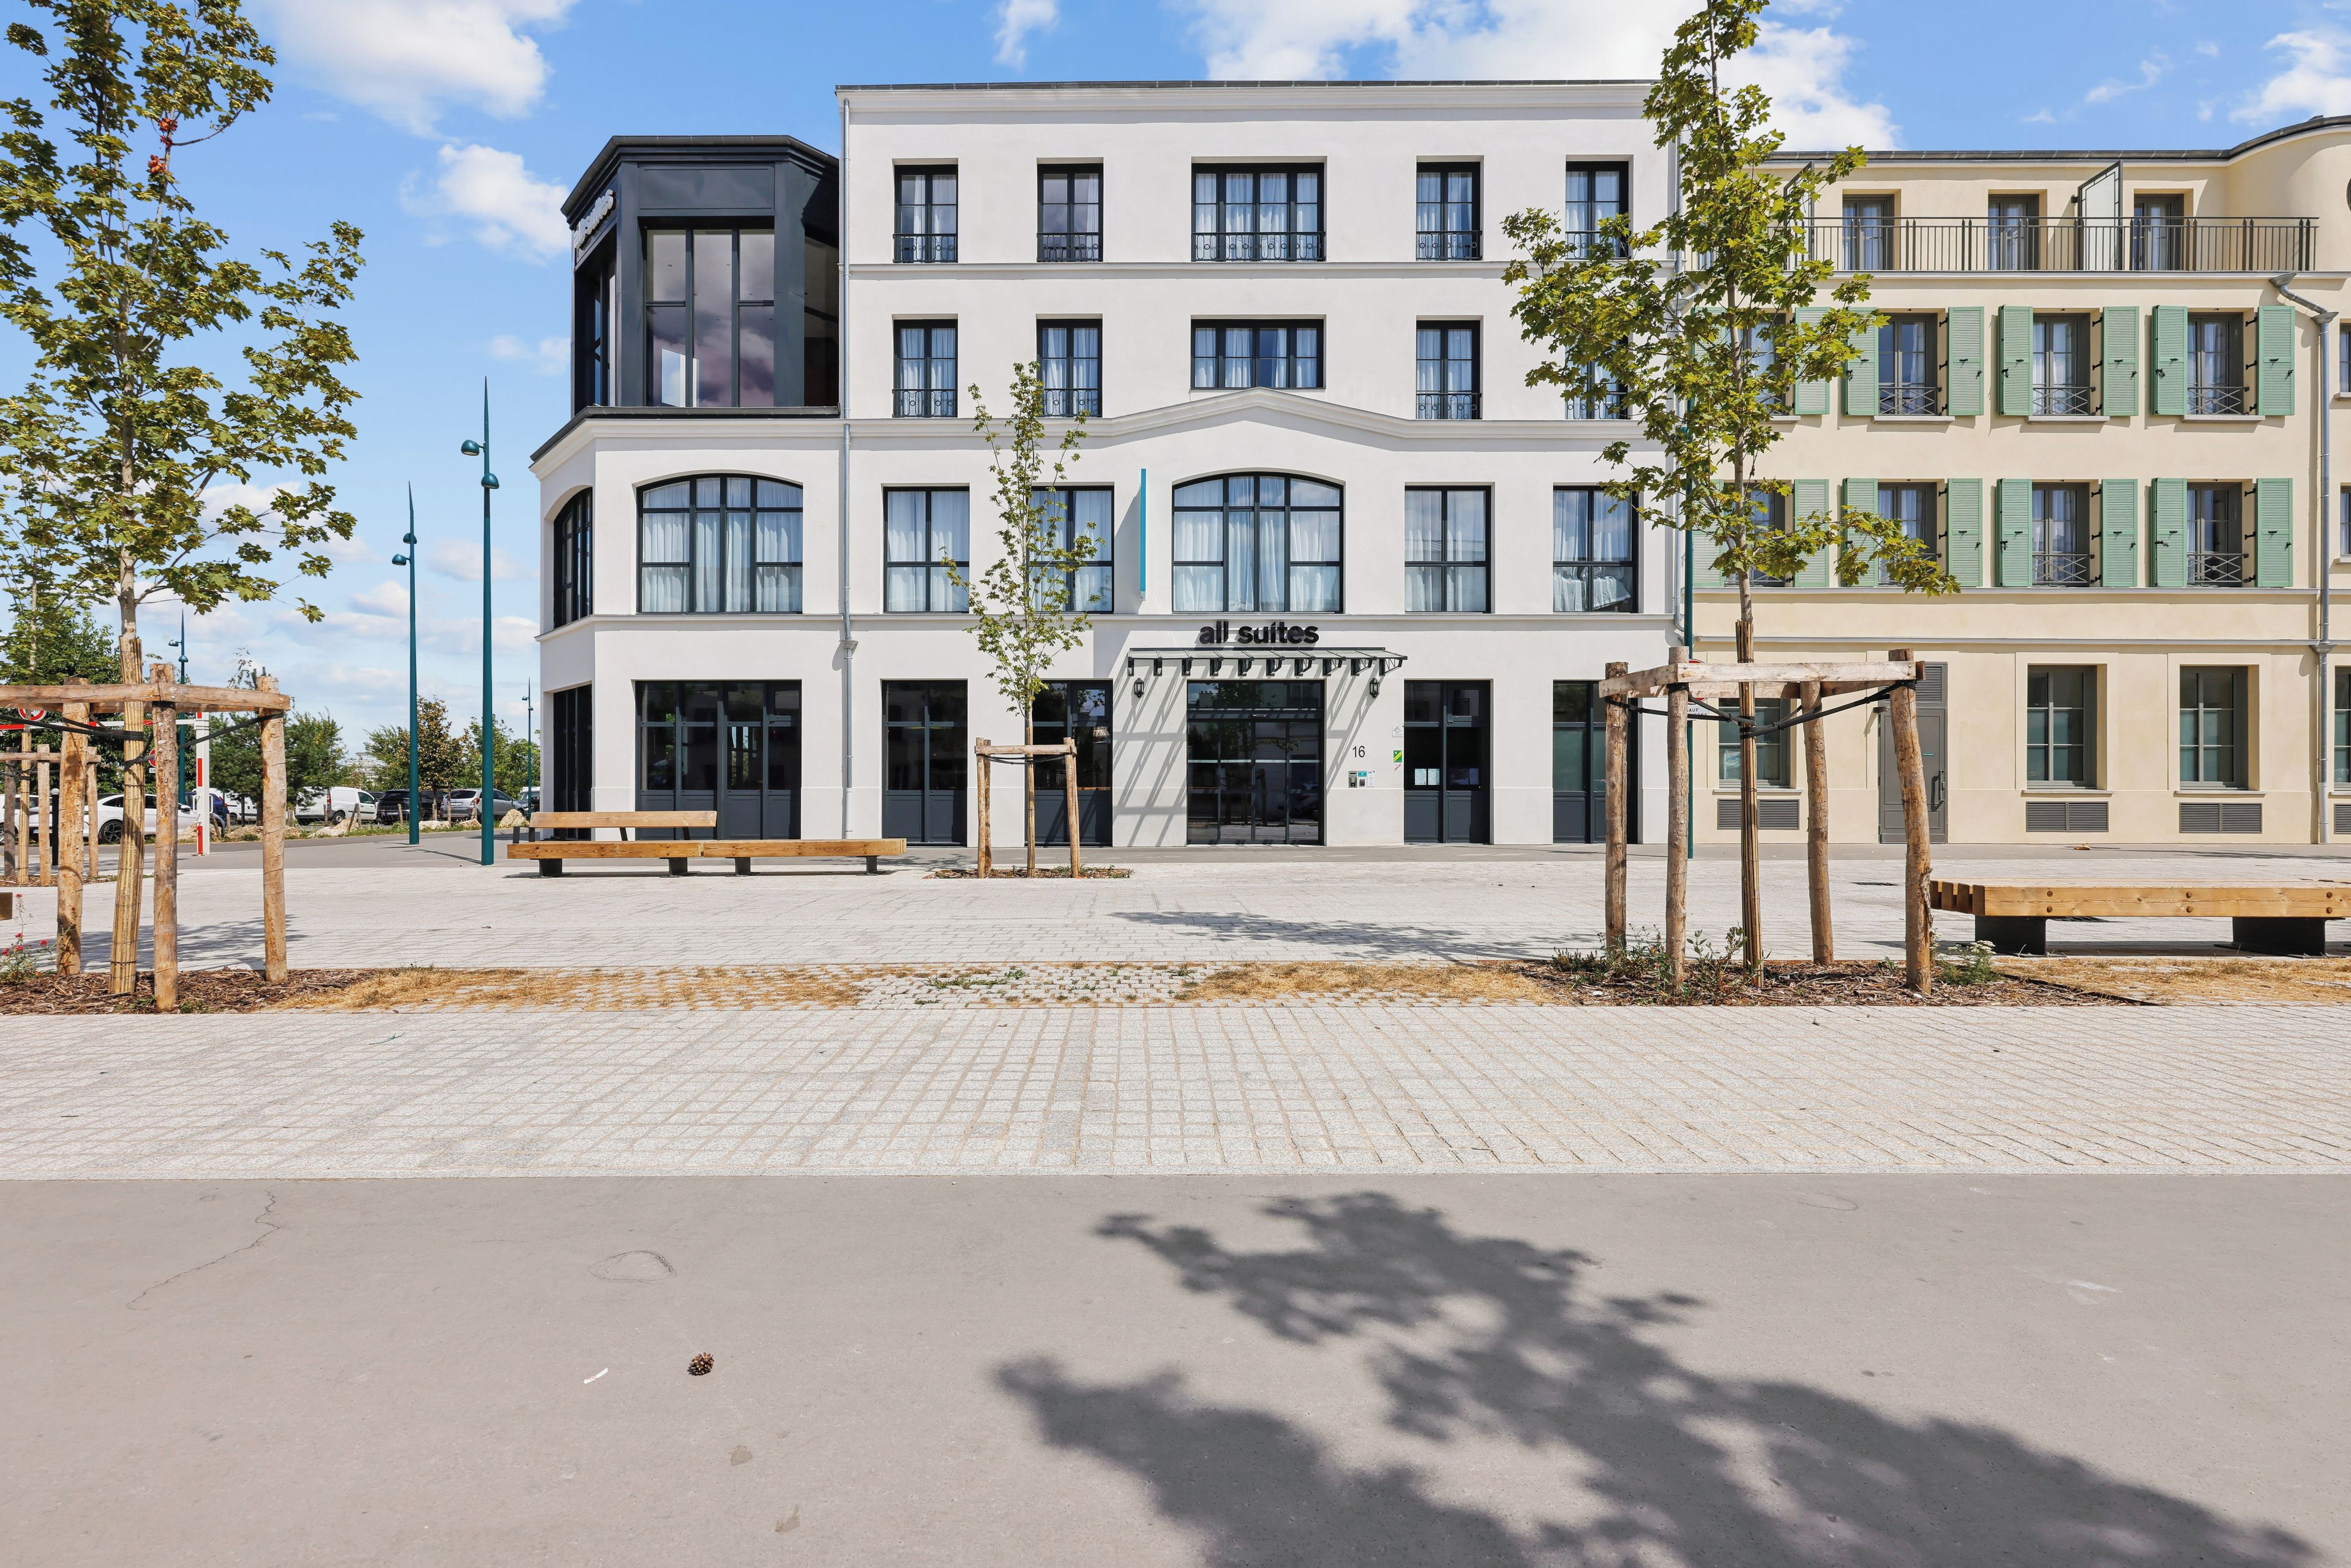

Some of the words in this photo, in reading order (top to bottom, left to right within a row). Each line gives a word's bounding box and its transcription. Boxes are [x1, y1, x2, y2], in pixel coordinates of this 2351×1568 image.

[1199, 621, 1229, 644] all
[1237, 621, 1319, 644] suites
[1352, 746, 1365, 758] 16
